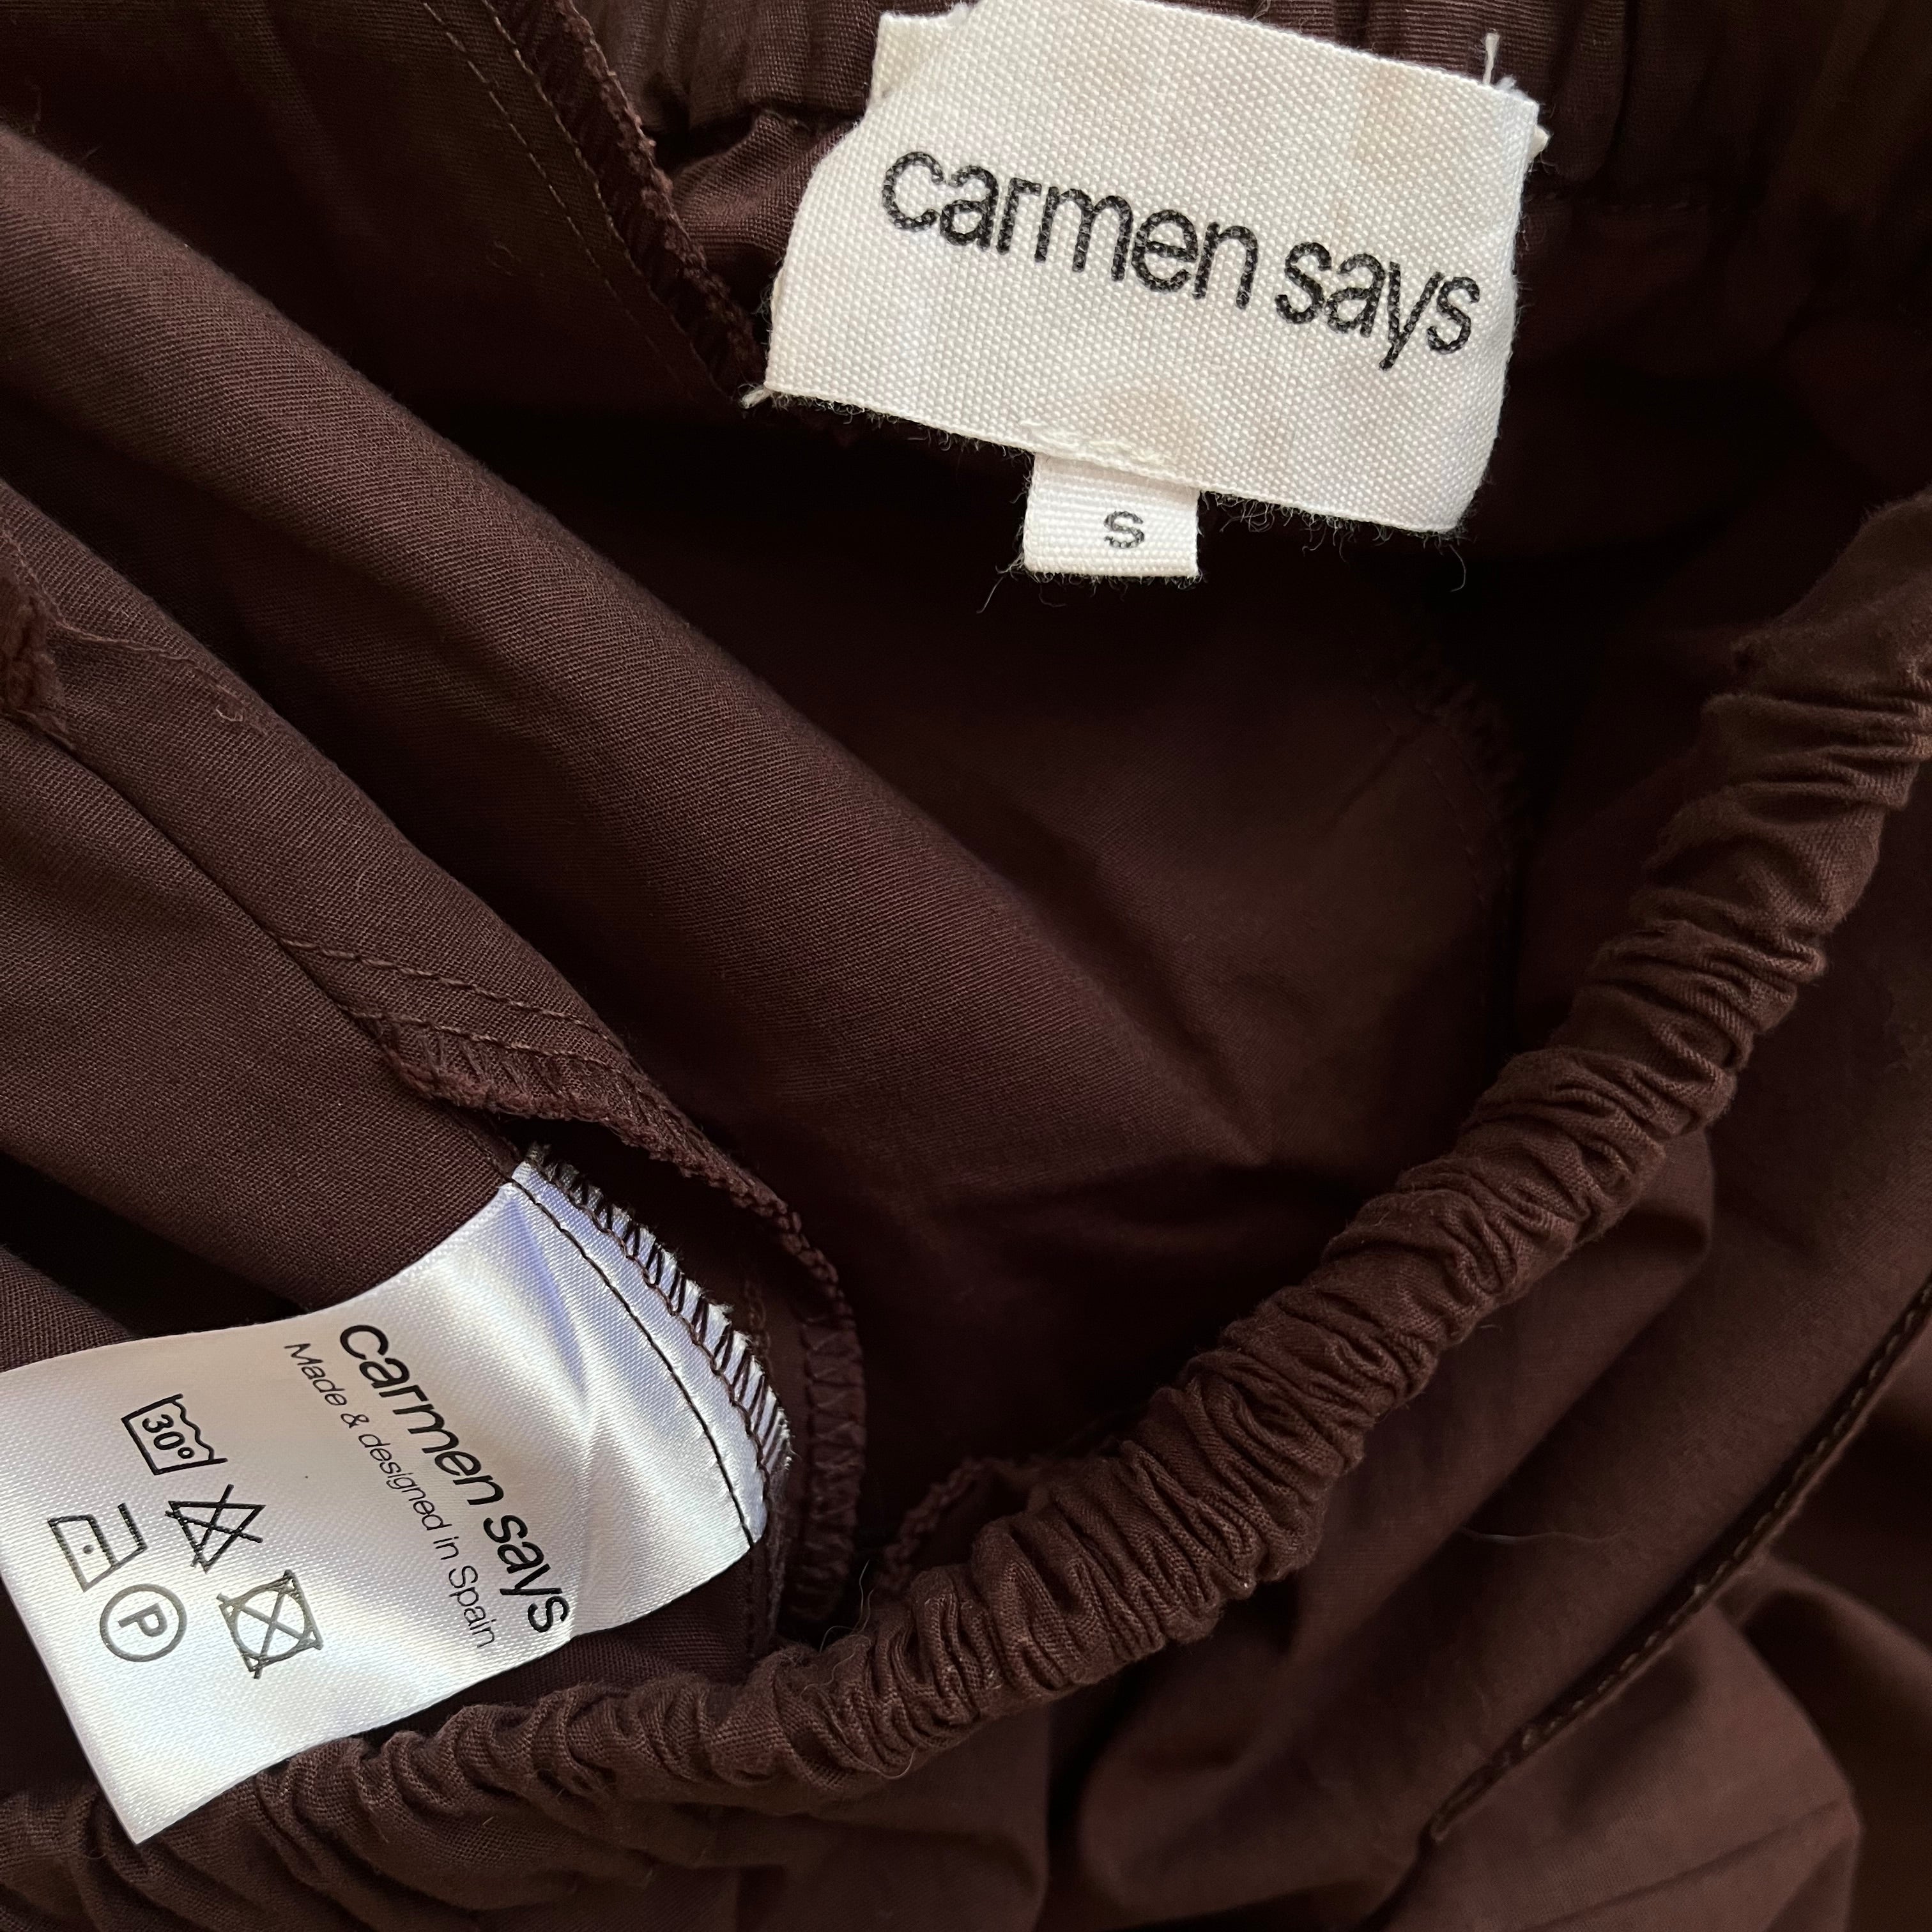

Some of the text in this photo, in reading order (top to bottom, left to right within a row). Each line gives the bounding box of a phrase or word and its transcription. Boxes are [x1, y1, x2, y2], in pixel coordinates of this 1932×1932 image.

[882, 151, 1480, 370] carmen says
[284, 1342, 497, 1648] Made & designed in Spain
[340, 1325, 569, 1632] carmen says
[118, 1603, 168, 1637] P
